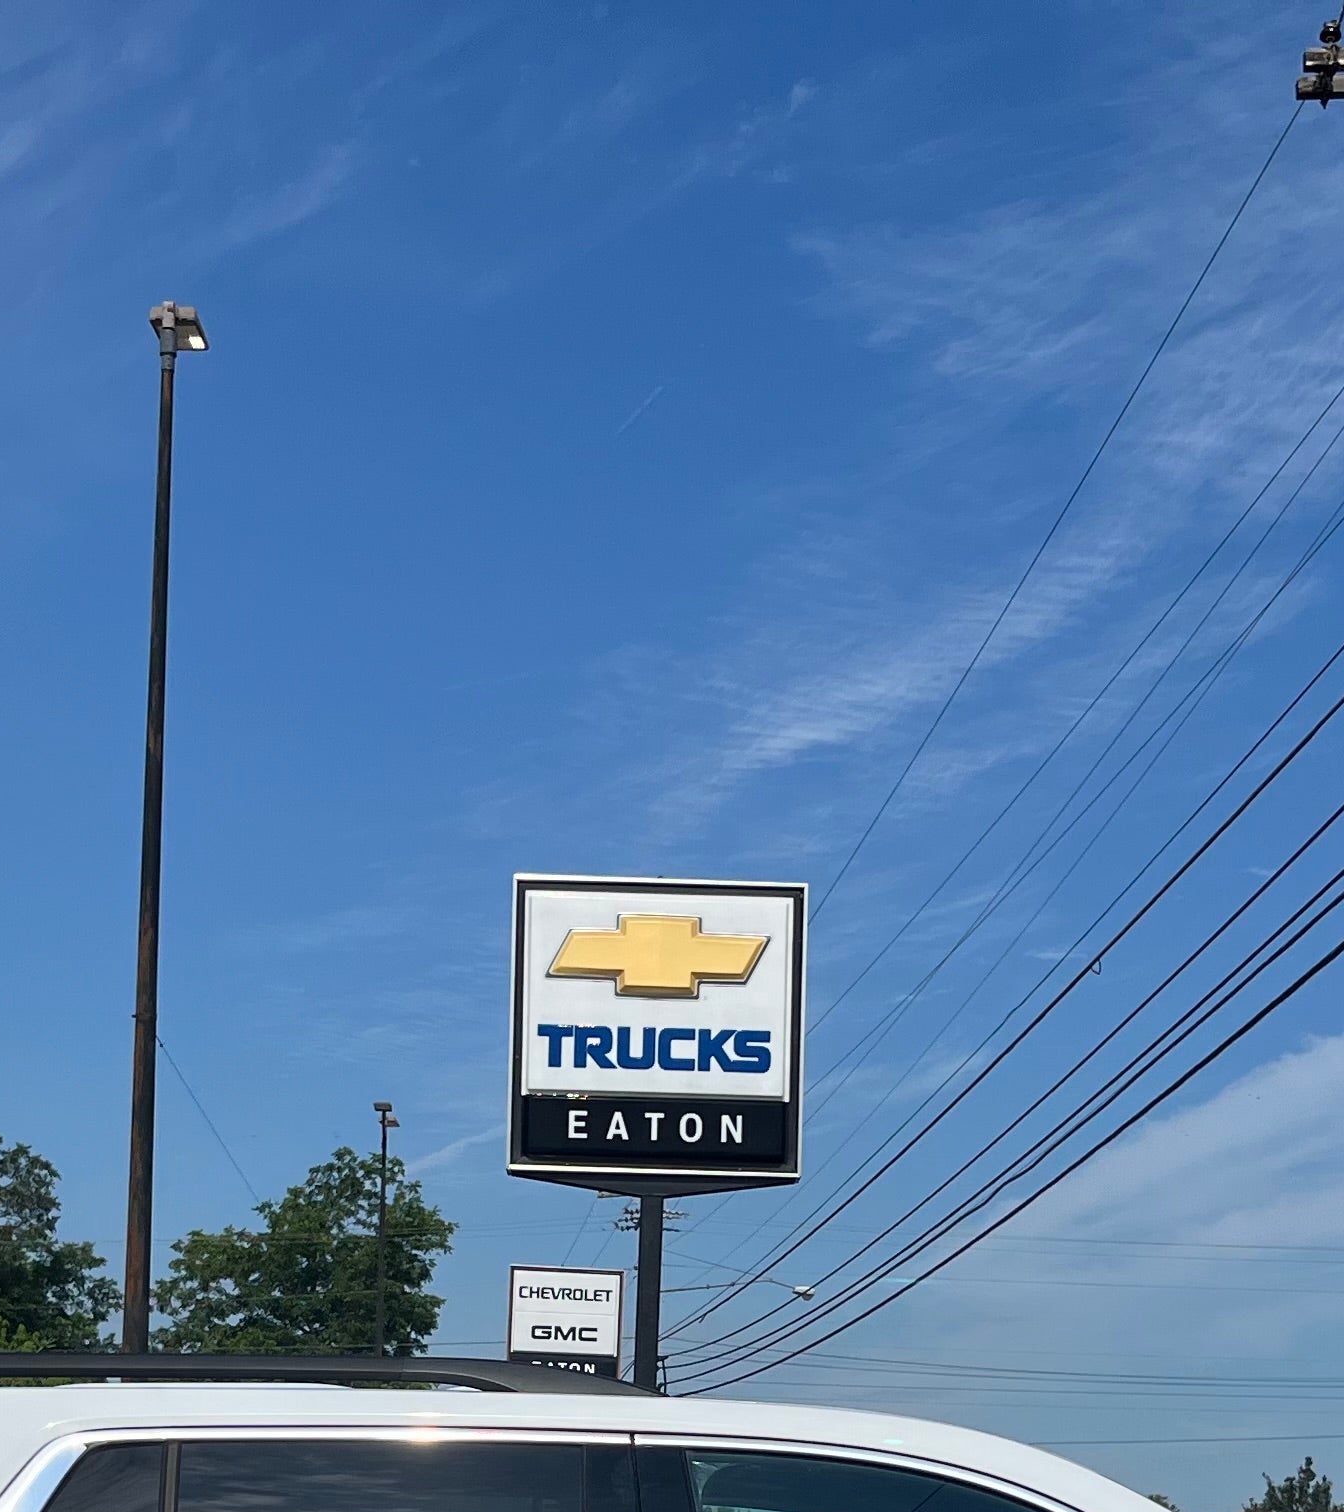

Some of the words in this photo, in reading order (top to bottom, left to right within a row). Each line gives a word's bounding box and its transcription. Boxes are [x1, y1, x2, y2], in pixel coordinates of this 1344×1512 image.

[537, 1023, 772, 1073] TRUCKS
[567, 1109, 743, 1144] EATON
[518, 1285, 613, 1302] CHEVROLET
[531, 1325, 598, 1342] GMC
